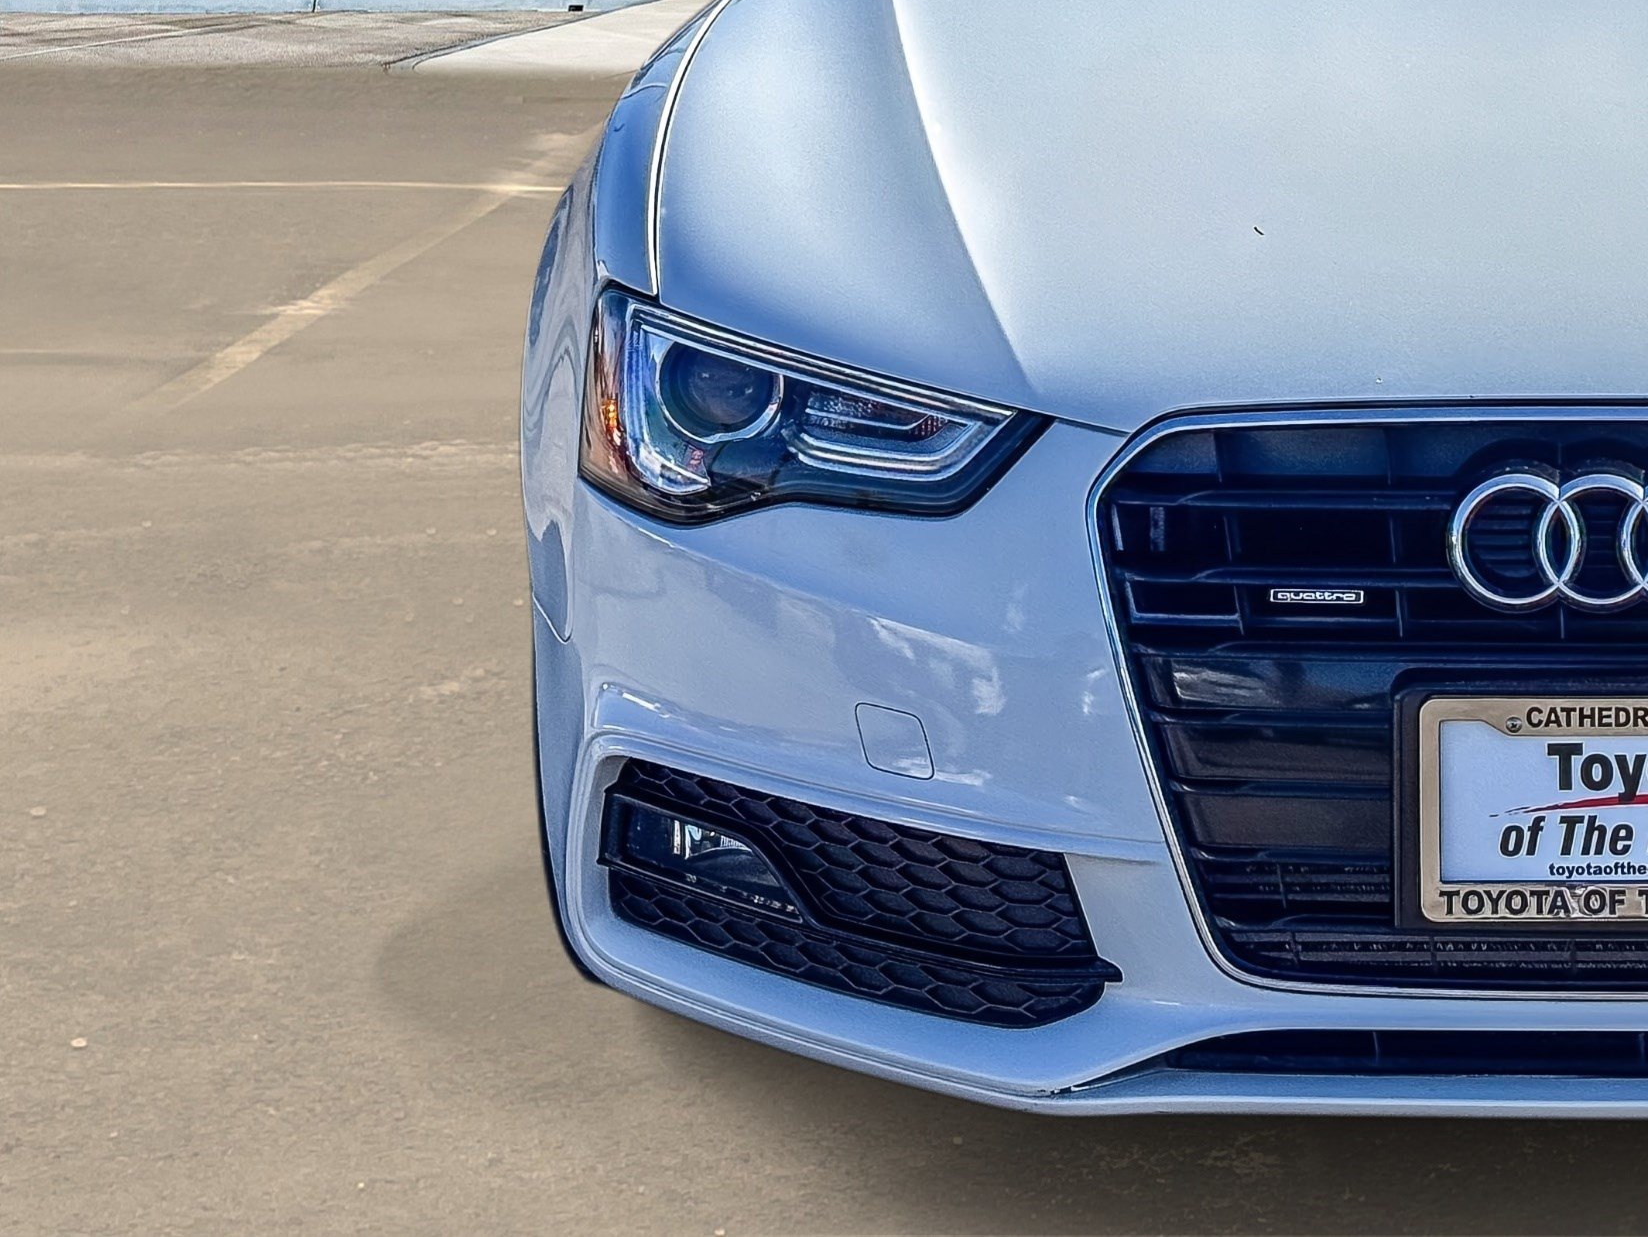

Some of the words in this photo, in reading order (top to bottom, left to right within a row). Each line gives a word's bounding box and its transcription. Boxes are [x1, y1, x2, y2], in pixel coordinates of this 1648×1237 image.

[1277, 592, 1356, 602] quattro
[1499, 816, 1544, 858] of
[1557, 814, 1634, 857] The
[1439, 888, 1572, 917] TOYOTA
[1581, 888, 1629, 917] OF
